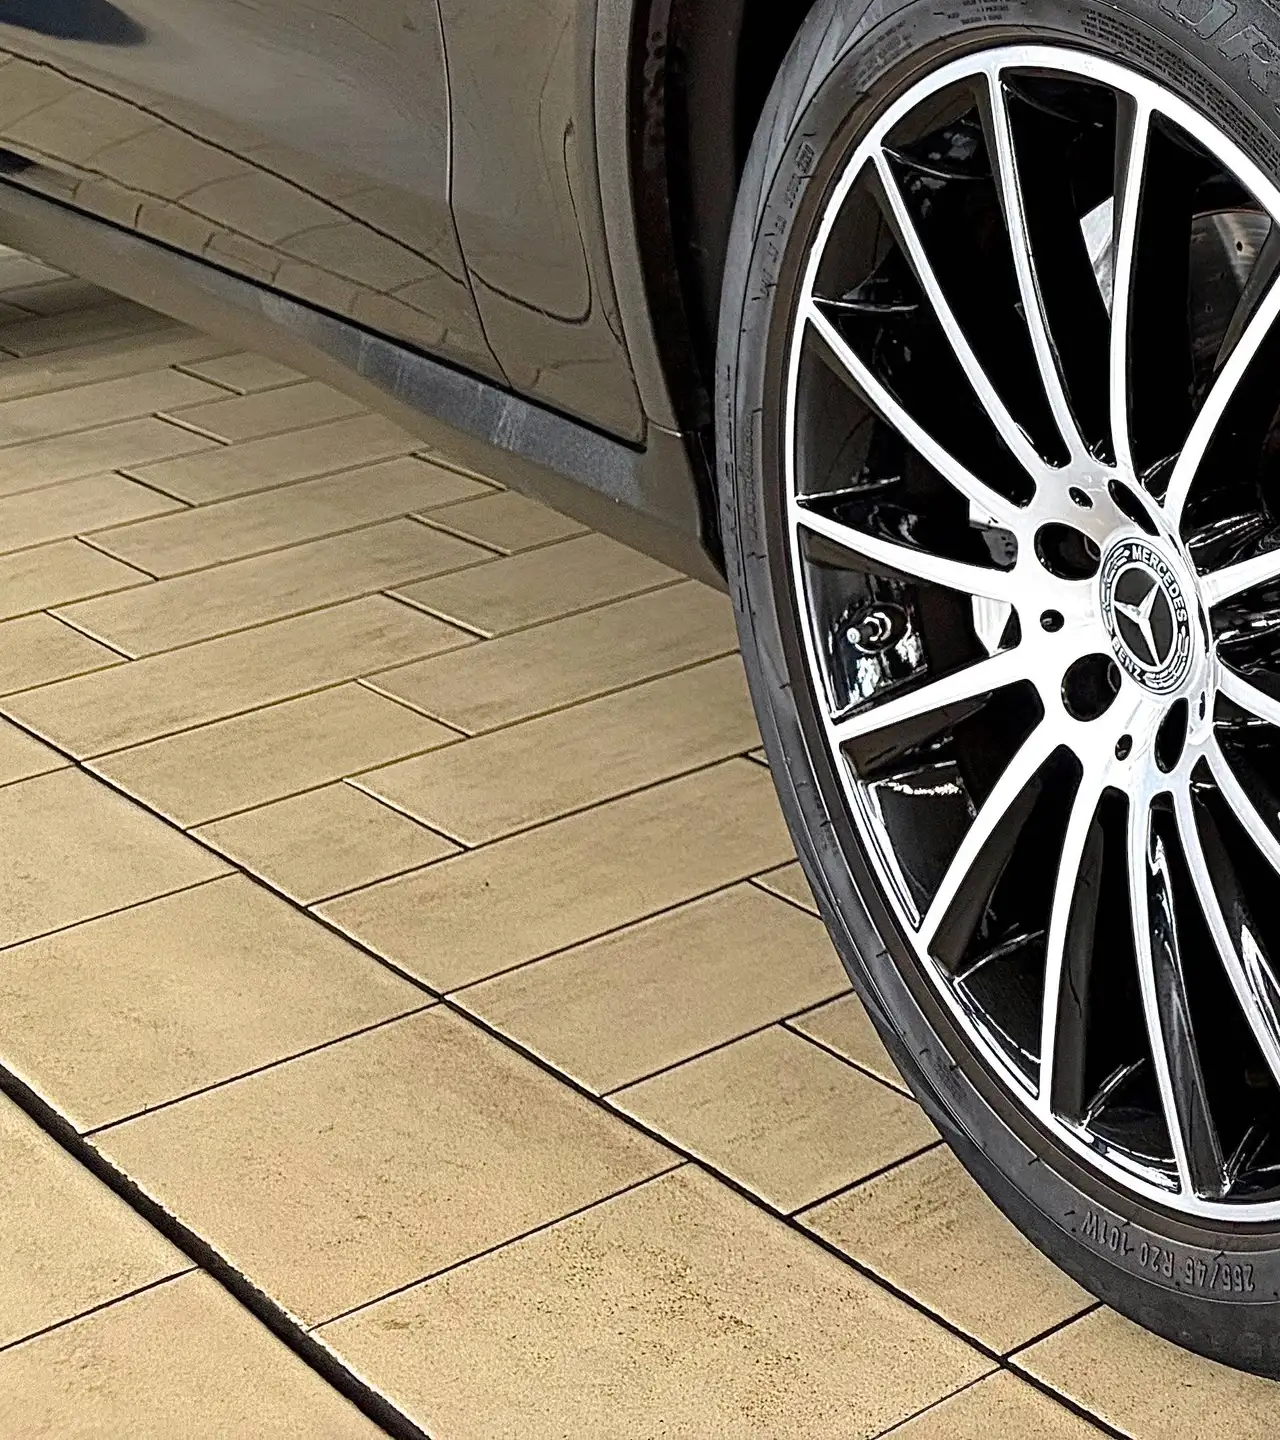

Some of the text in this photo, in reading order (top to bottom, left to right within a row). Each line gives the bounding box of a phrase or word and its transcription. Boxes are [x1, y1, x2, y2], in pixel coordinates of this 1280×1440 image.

[1131, 544, 1189, 623] MERCEDES
[1111, 636, 1146, 682] BENZ
[1080, 1210, 1256, 1292] 255/45 R20 101W
